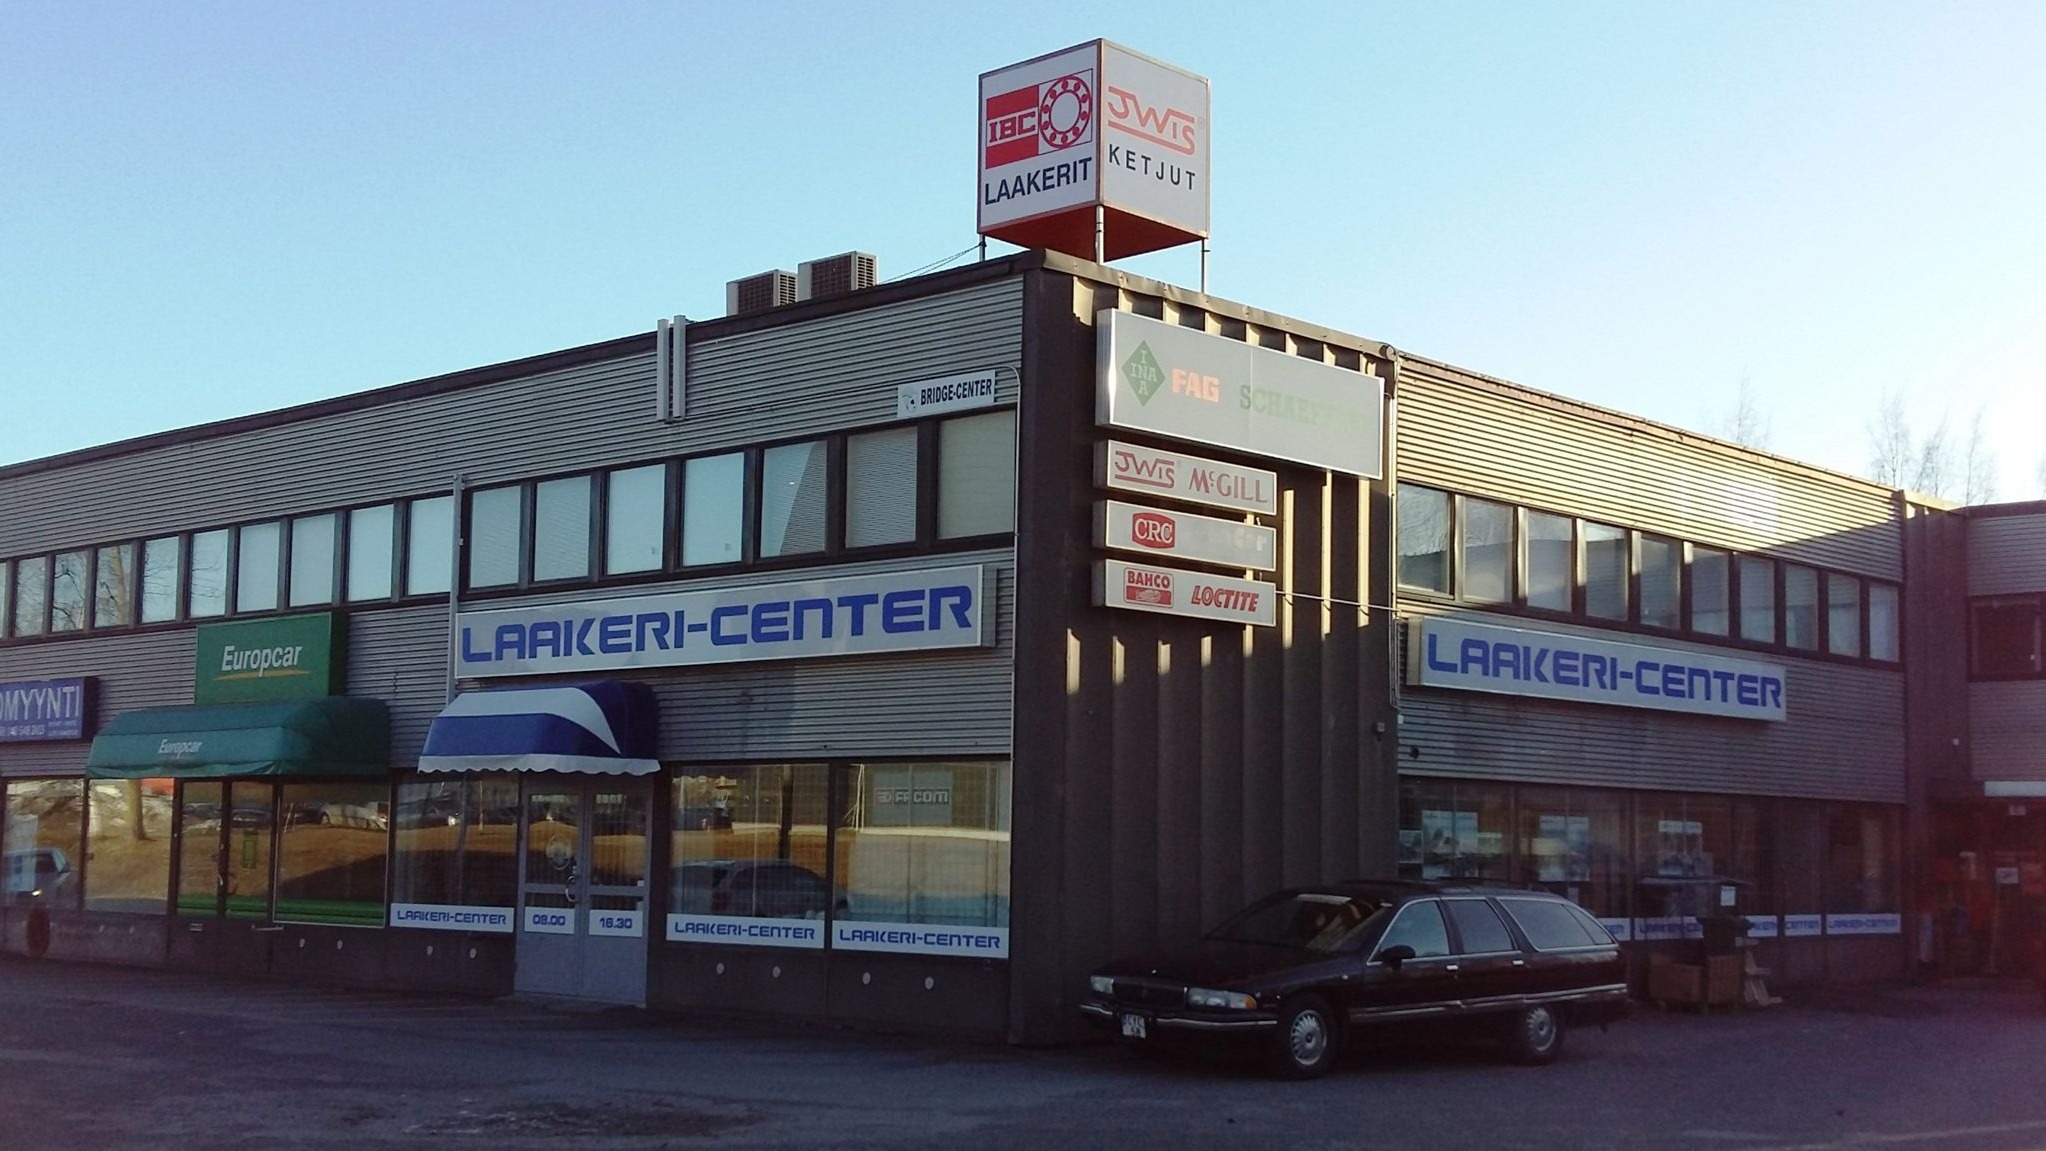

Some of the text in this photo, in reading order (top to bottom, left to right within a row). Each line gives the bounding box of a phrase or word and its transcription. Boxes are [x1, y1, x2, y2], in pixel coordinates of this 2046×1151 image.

[989, 111, 1036, 143] IBC
[1109, 144, 1196, 190] KETJUT
[985, 157, 1093, 205] LAAKERIT
[921, 378, 992, 405] BRIDGE-CENTER
[1172, 368, 1220, 402] FAG
[1134, 516, 1173, 544] CRC
[1127, 570, 1171, 589] BAHCO
[1191, 585, 1260, 612] LOCTITE
[462, 585, 972, 662] LAAKERI-CENTER
[221, 645, 302, 677] Europcar
[1428, 633, 1781, 708] LAAKERI-CENTER
[158, 739, 202, 757] Europcar
[396, 910, 506, 925] LAAKERI-CENTER
[532, 915, 566, 927] 08.00
[599, 917, 633, 930] 16.30
[674, 921, 815, 940] LAAKERI-CENTER
[839, 928, 1001, 949] LAAKERI-CENTER
